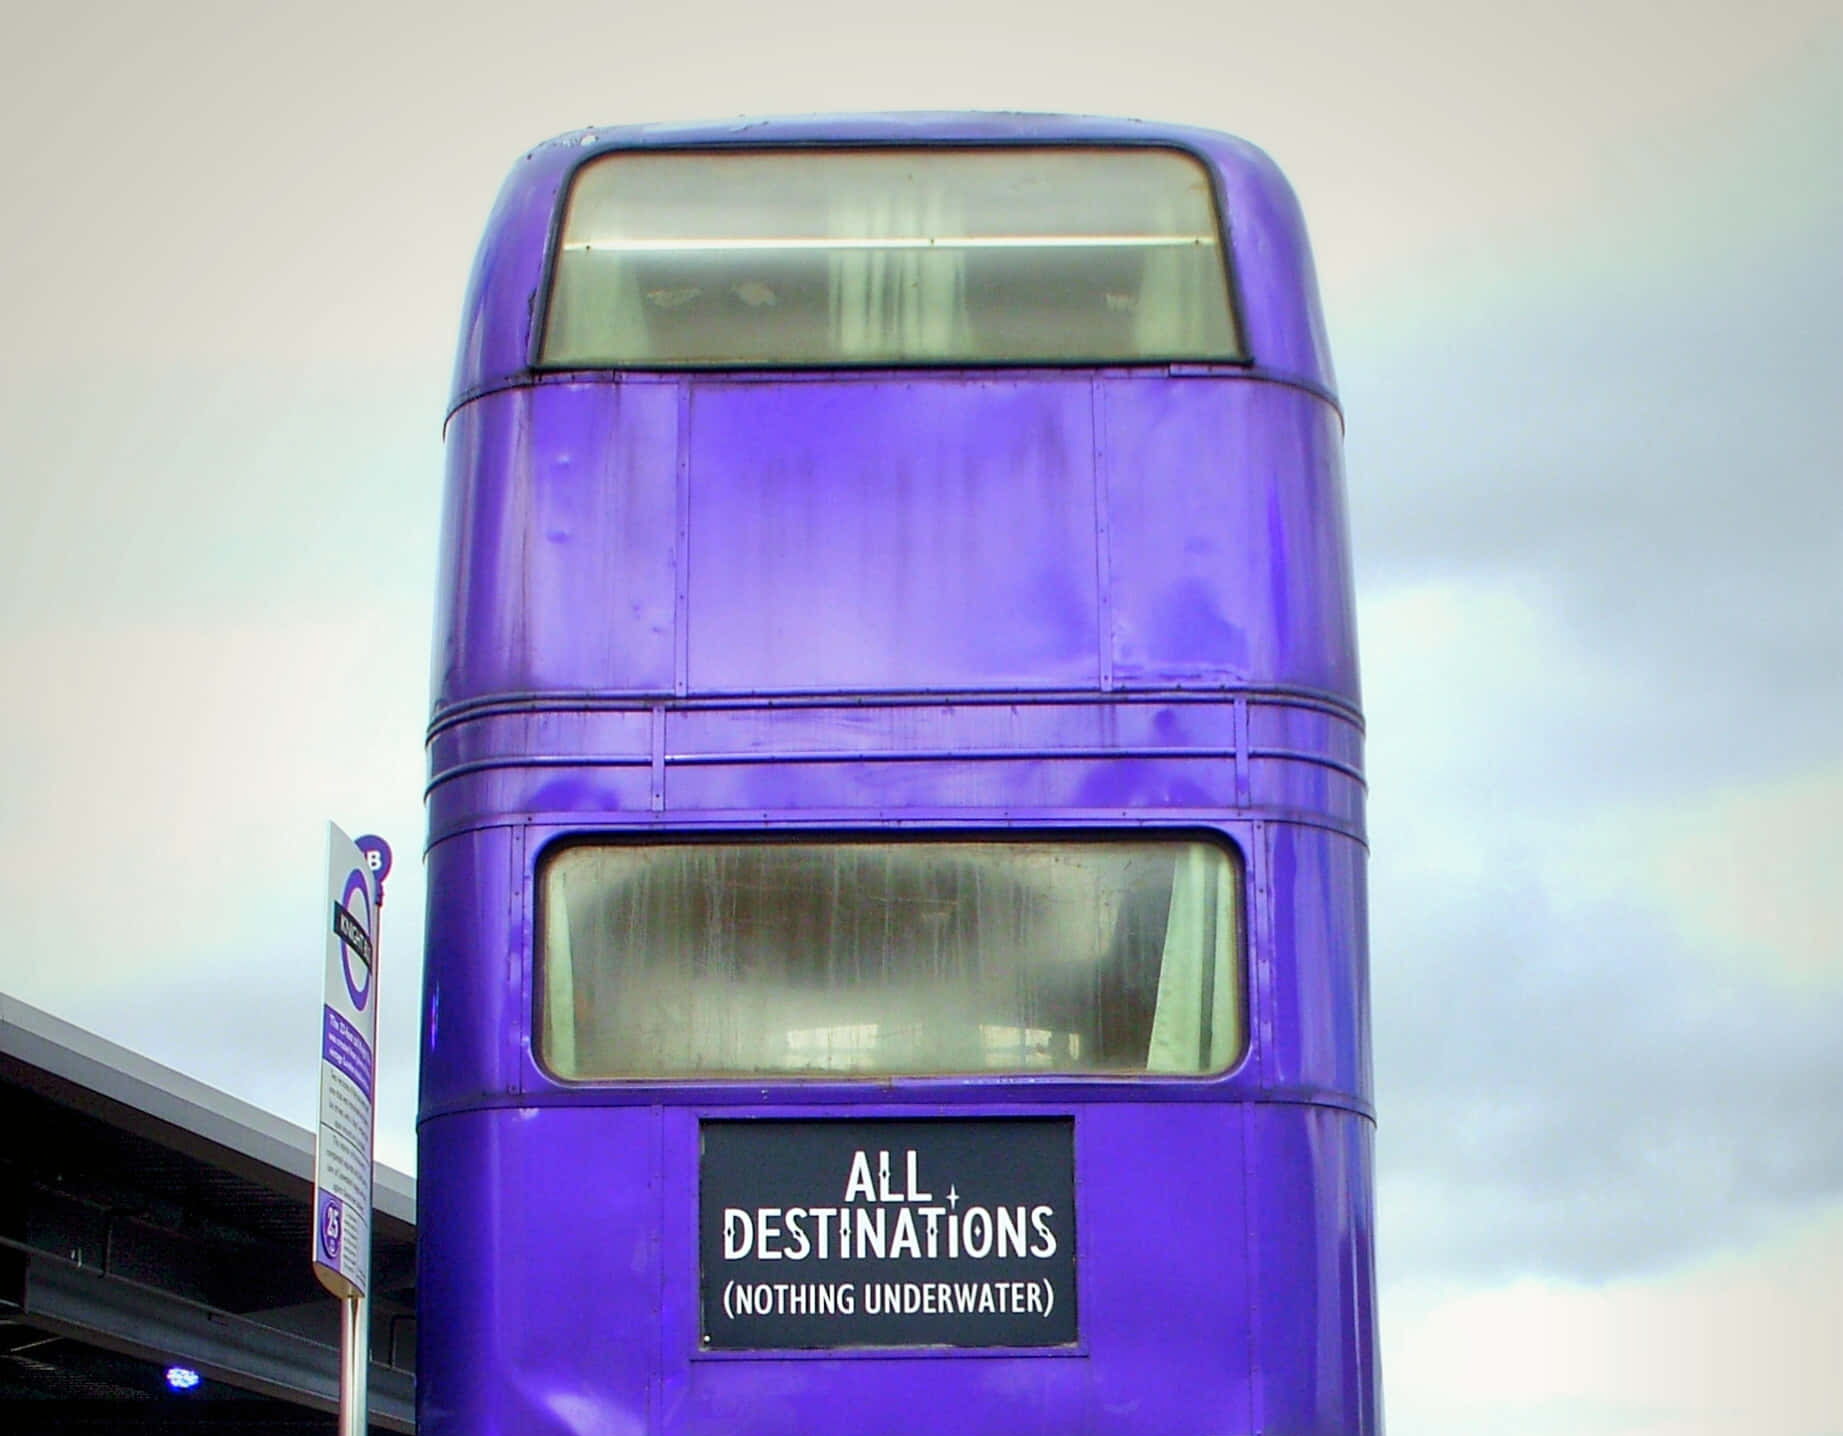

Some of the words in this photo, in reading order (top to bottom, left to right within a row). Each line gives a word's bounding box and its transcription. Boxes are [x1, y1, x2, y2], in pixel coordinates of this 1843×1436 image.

[366, 850, 382, 871] B
[845, 1150, 933, 1202] ALL
[723, 1280, 855, 1319] (NOTHING
[864, 1278, 1054, 1317] UNDERWATER)
